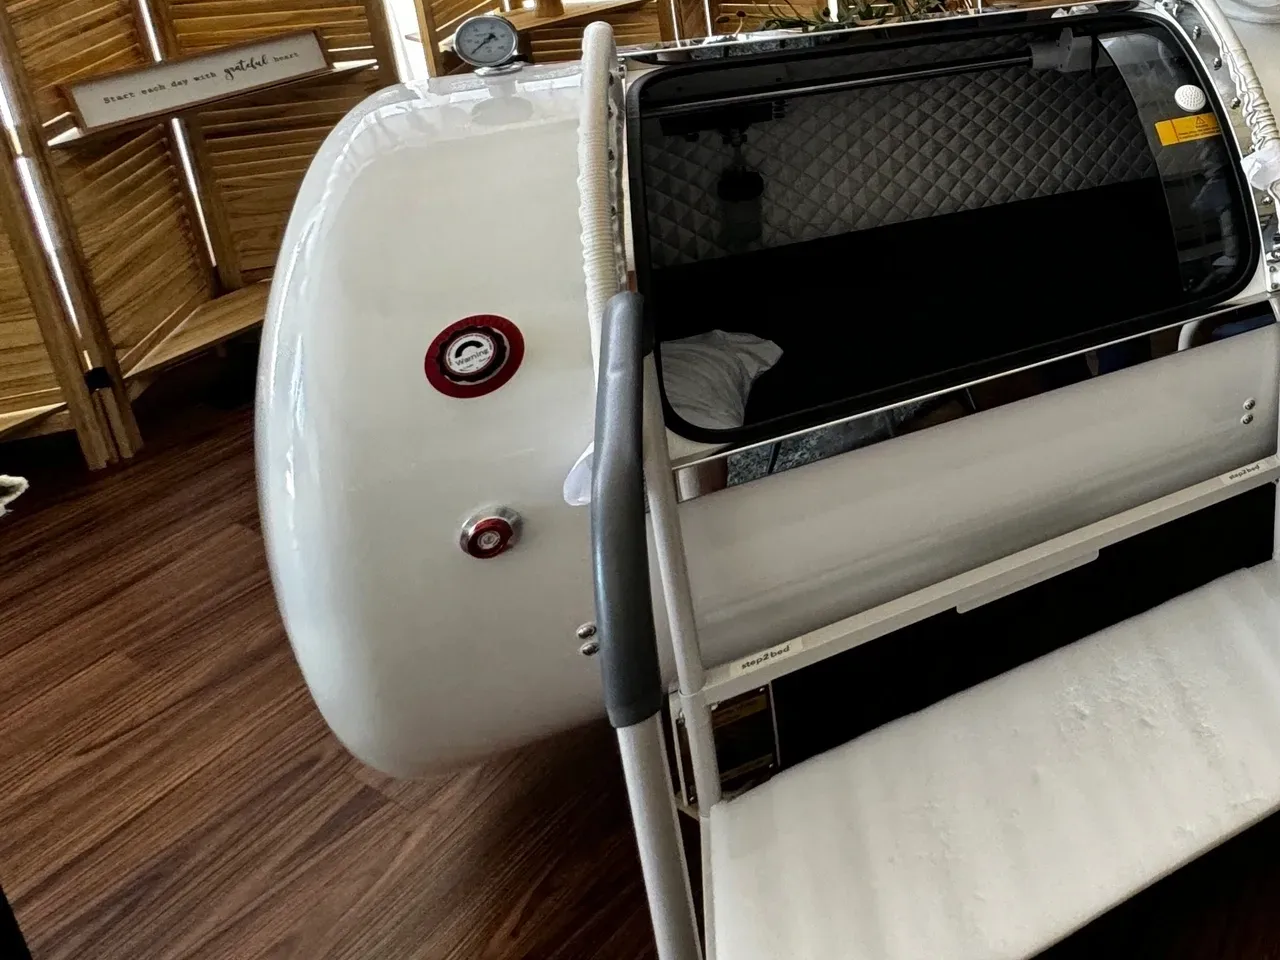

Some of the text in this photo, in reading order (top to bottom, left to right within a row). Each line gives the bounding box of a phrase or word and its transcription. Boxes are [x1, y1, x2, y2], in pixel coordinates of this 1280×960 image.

[103, 52, 300, 105] Start each day with grateful heart
[455, 348, 490, 366] Warning
[741, 645, 791, 670] step2bed
